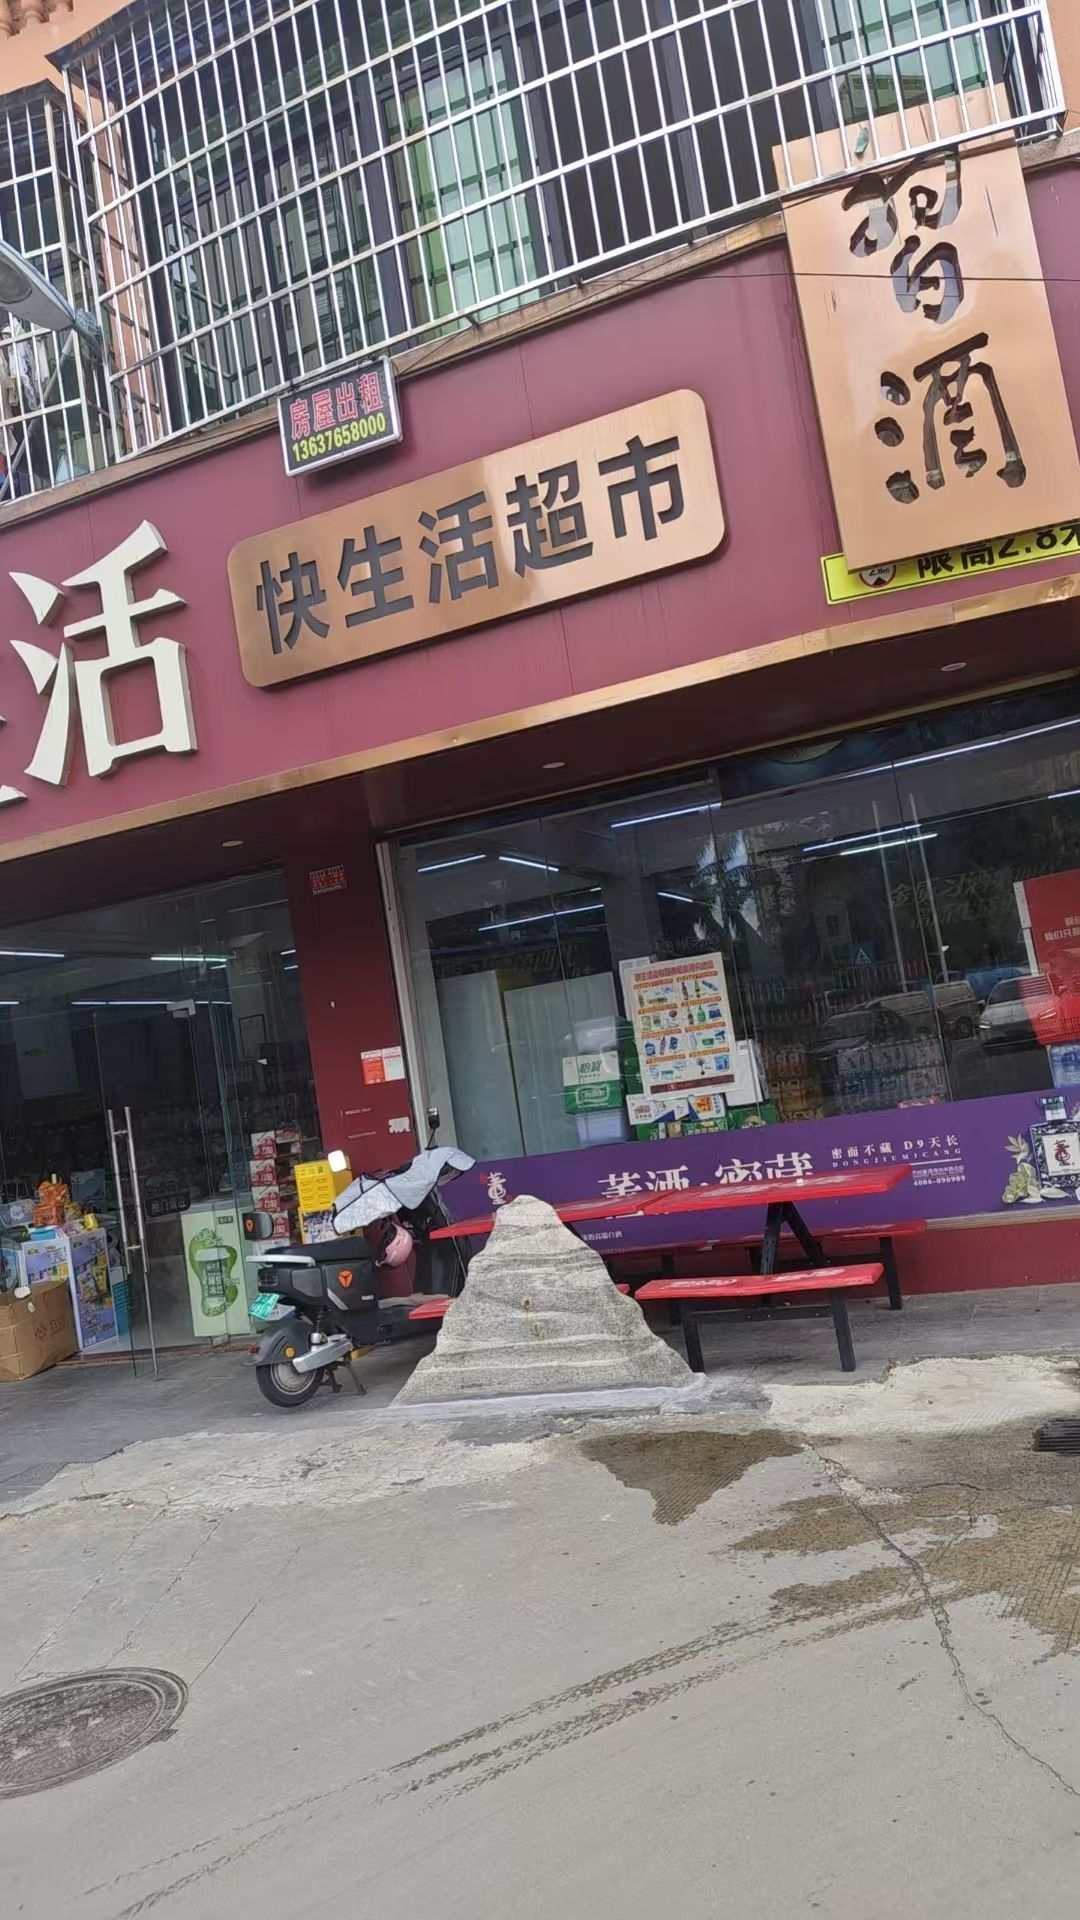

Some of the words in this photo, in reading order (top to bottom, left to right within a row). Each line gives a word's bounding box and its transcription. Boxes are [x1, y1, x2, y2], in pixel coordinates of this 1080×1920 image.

[289, 371, 384, 440] 房屋出租
[292, 412, 386, 462] 13637658000
[256, 436, 686, 654] 快生活超市
